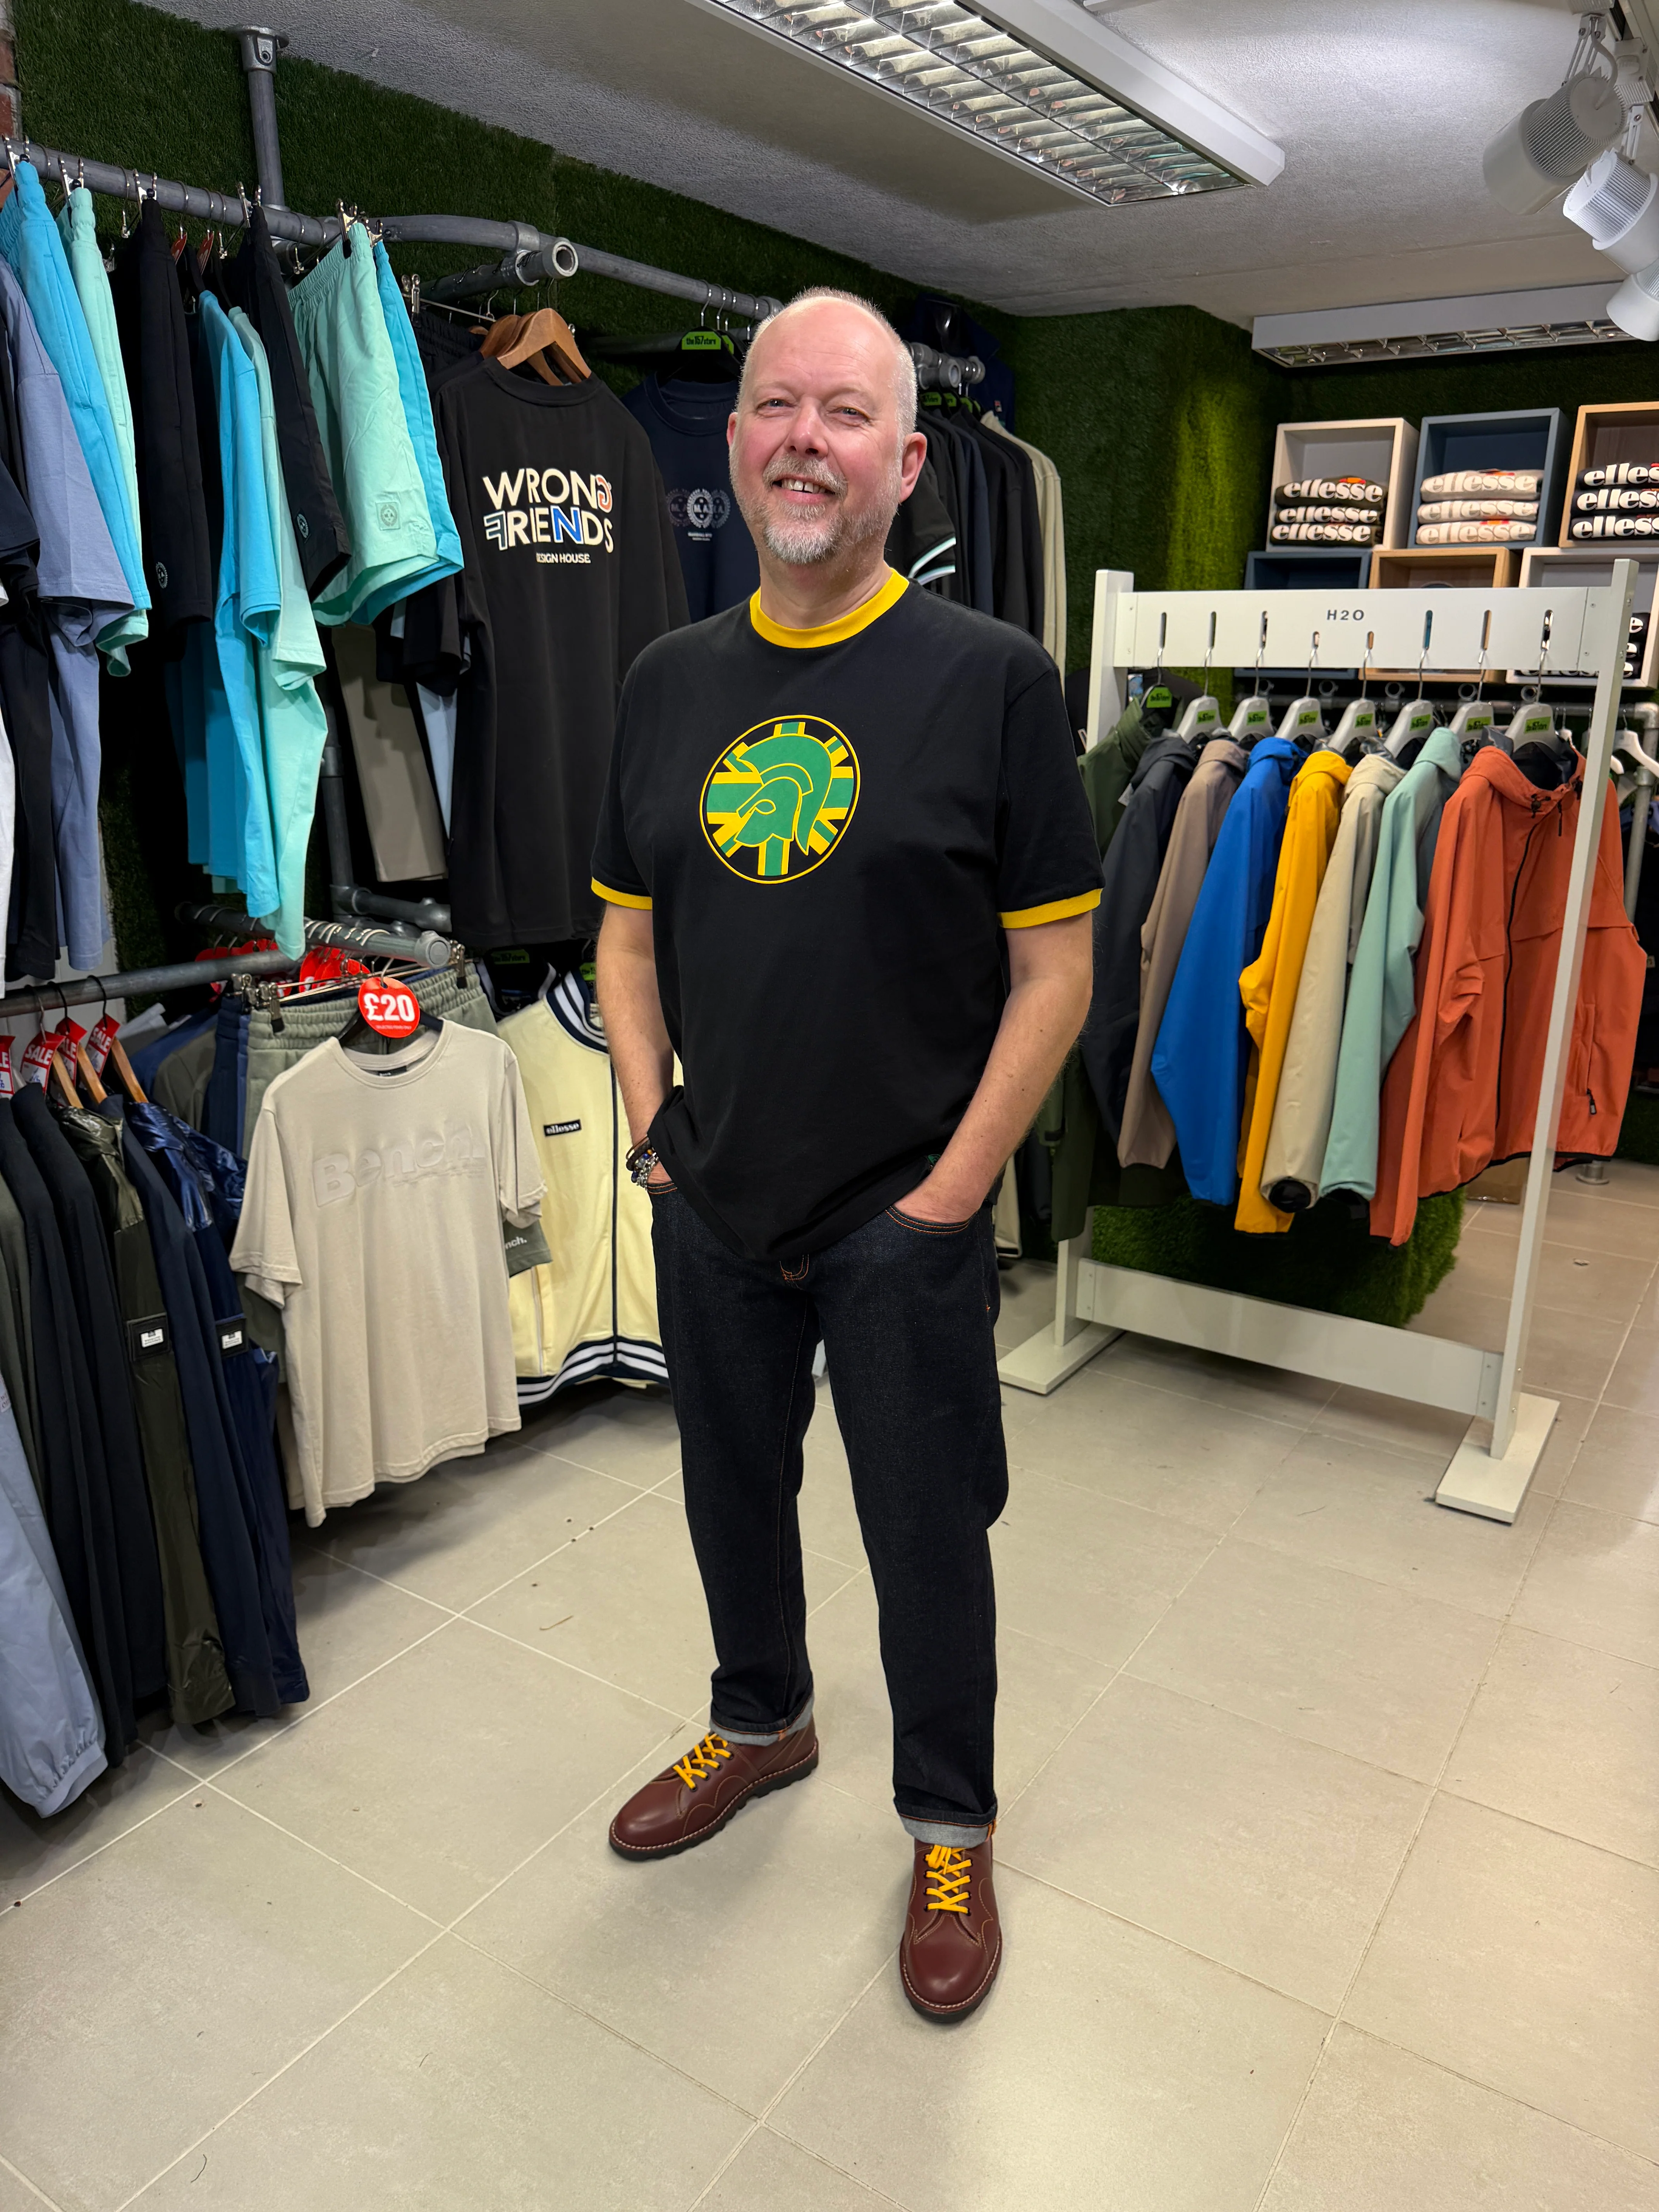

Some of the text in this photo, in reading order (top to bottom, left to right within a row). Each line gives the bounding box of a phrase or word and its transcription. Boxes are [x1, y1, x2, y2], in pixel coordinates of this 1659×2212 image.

[482, 468, 613, 513] WRONG
[1283, 479, 1383, 502] ellesse
[1424, 472, 1535, 493] ellesse
[1421, 500, 1534, 520] ellesse
[1577, 489, 1659, 511] elles
[1279, 506, 1377, 523] ellesse
[483, 505, 614, 553] FRIENDS
[1272, 523, 1371, 542] ellesse
[1420, 522, 1531, 544] ellesse
[559, 552, 591, 563] HOUSE
[1327, 609, 1364, 621] H2O
[363, 993, 415, 1022] £20
[59, 1038, 77, 1059] ALE
[91, 1027, 112, 1053] SALE
[25, 1044, 53, 1065] SALE
[546, 1122, 580, 1135] ellesse
[505, 1236, 527, 1250] nch.
